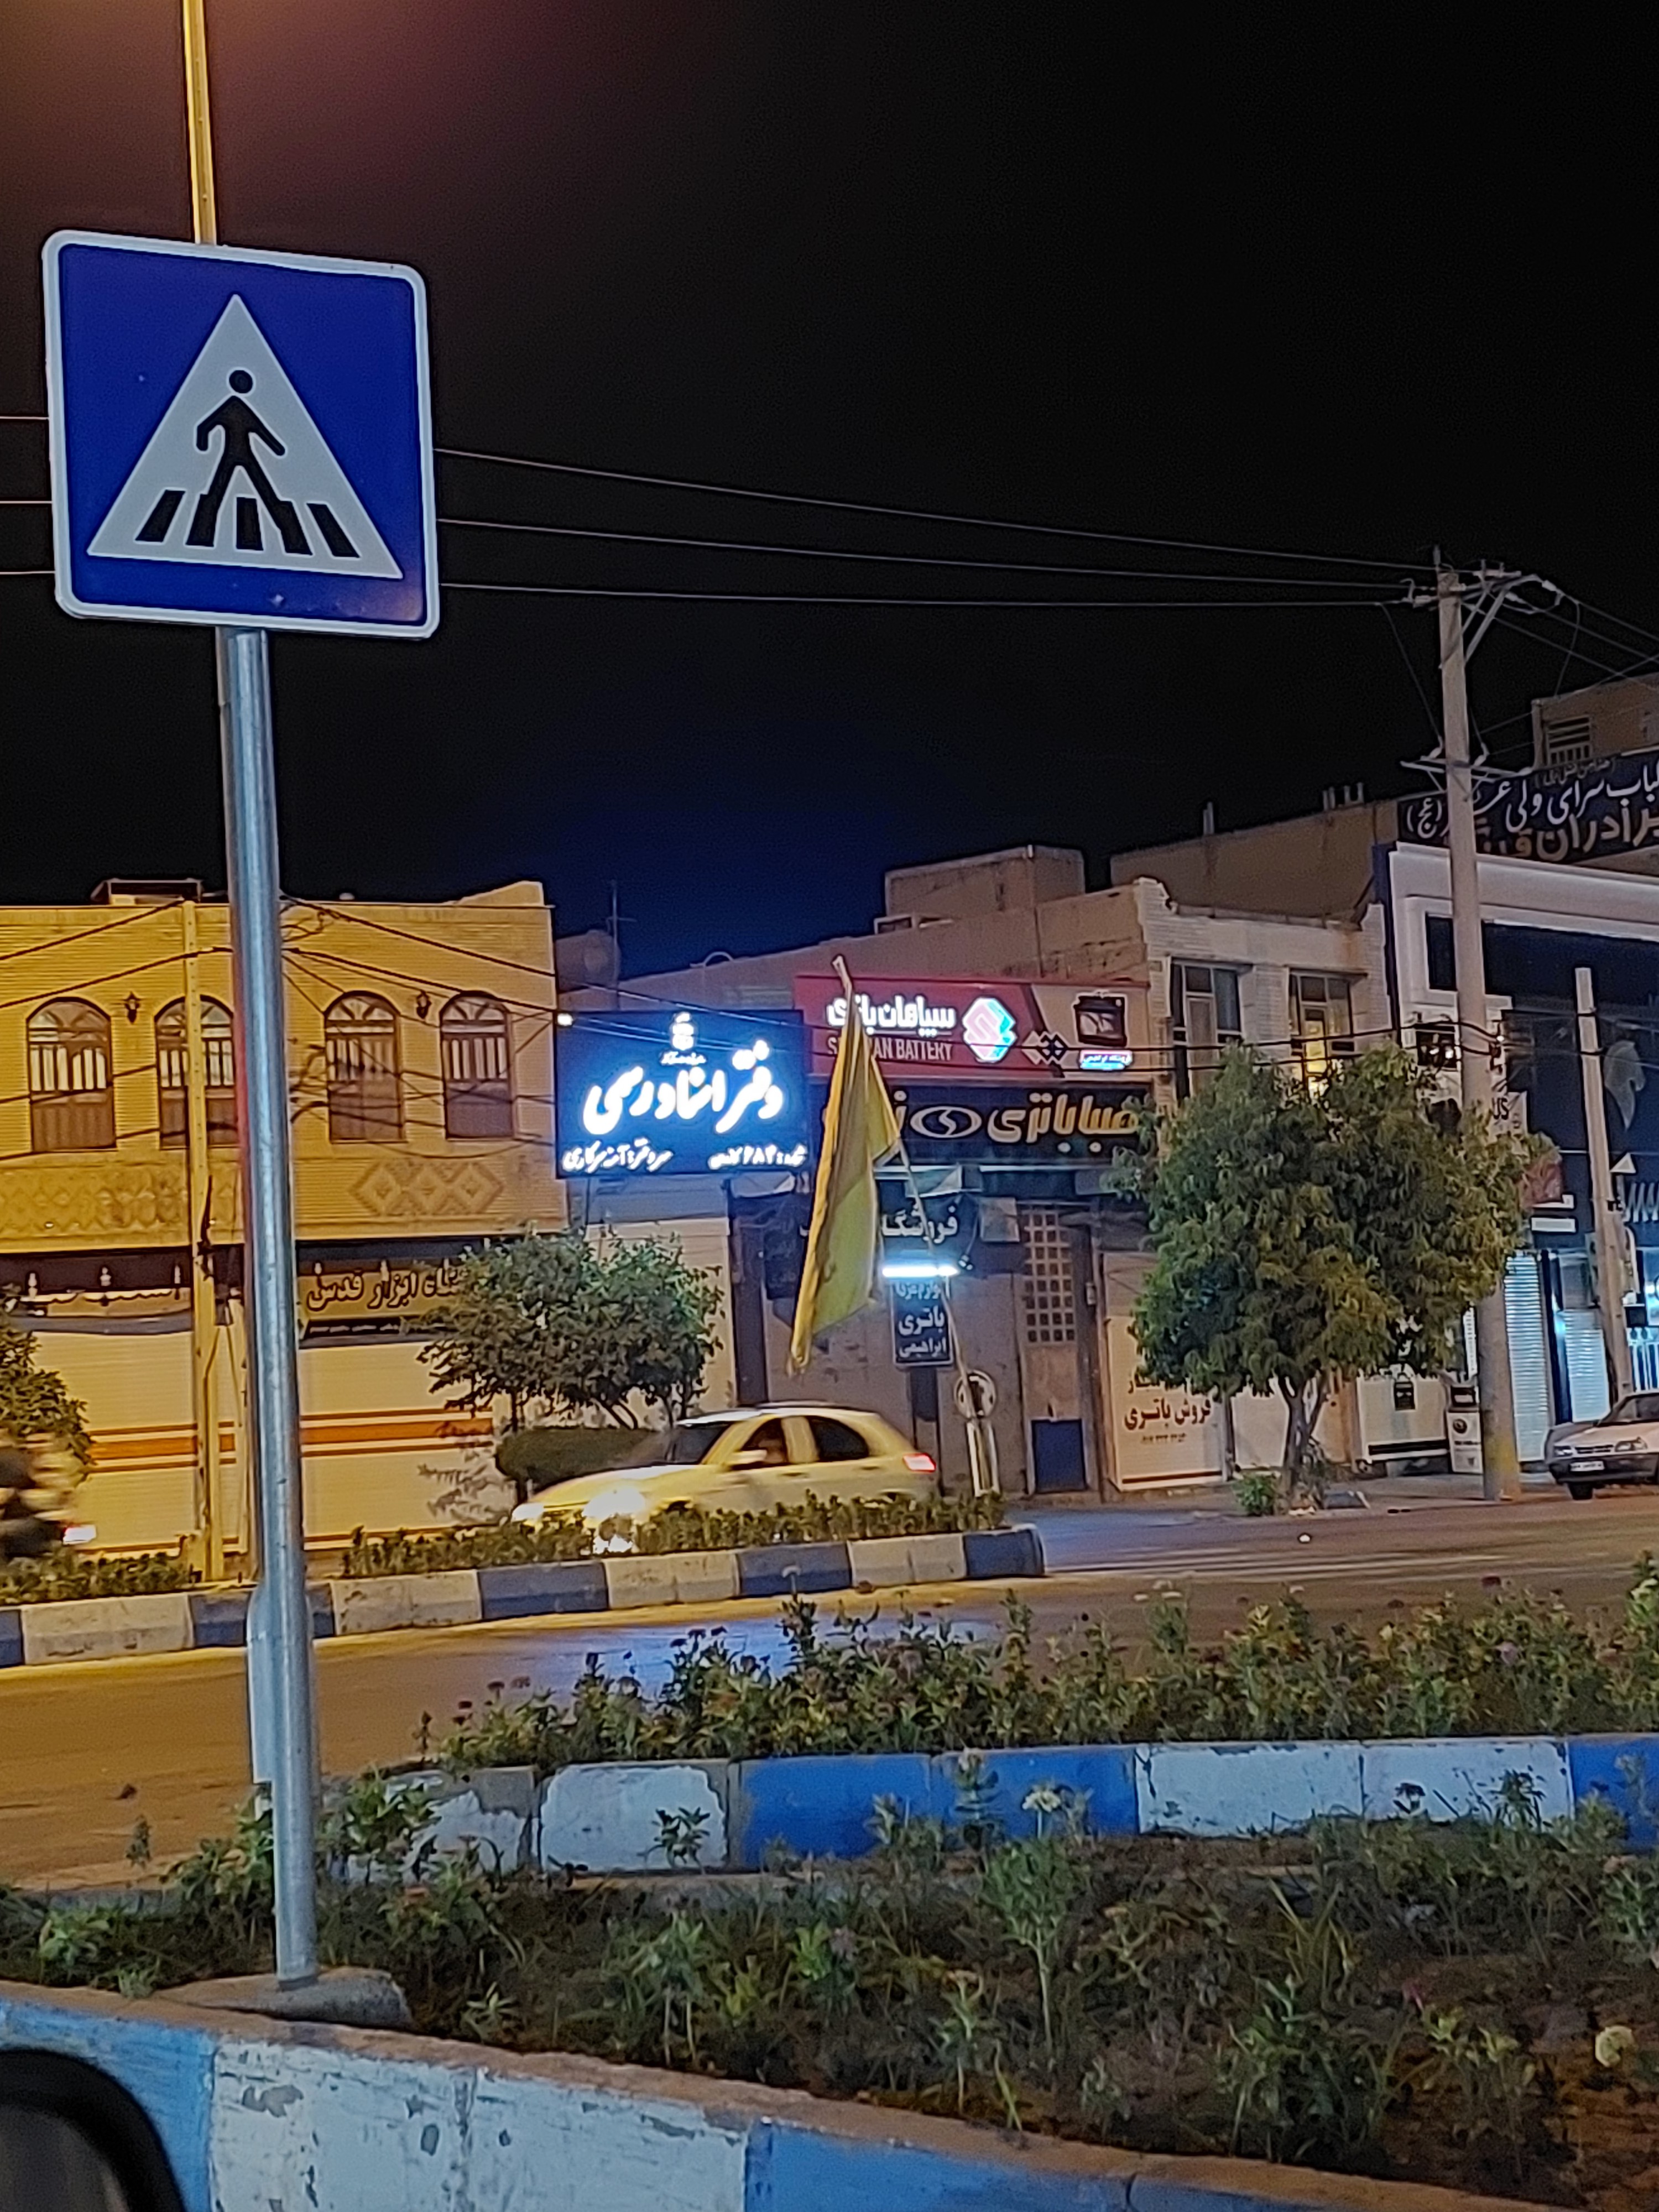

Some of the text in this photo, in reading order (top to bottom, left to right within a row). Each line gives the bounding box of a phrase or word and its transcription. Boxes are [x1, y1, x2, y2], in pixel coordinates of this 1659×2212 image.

[1606, 765, 1659, 806] باب
[895, 1037, 953, 1061] BATTERY
[987, 1093, 1140, 1153] صبا باتری
[881, 1203, 958, 1244] فروشگا
[898, 1306, 945, 1335] باتری
[899, 1337, 947, 1358] ابراهیمی
[1124, 1397, 1212, 1431] فروش باتری
